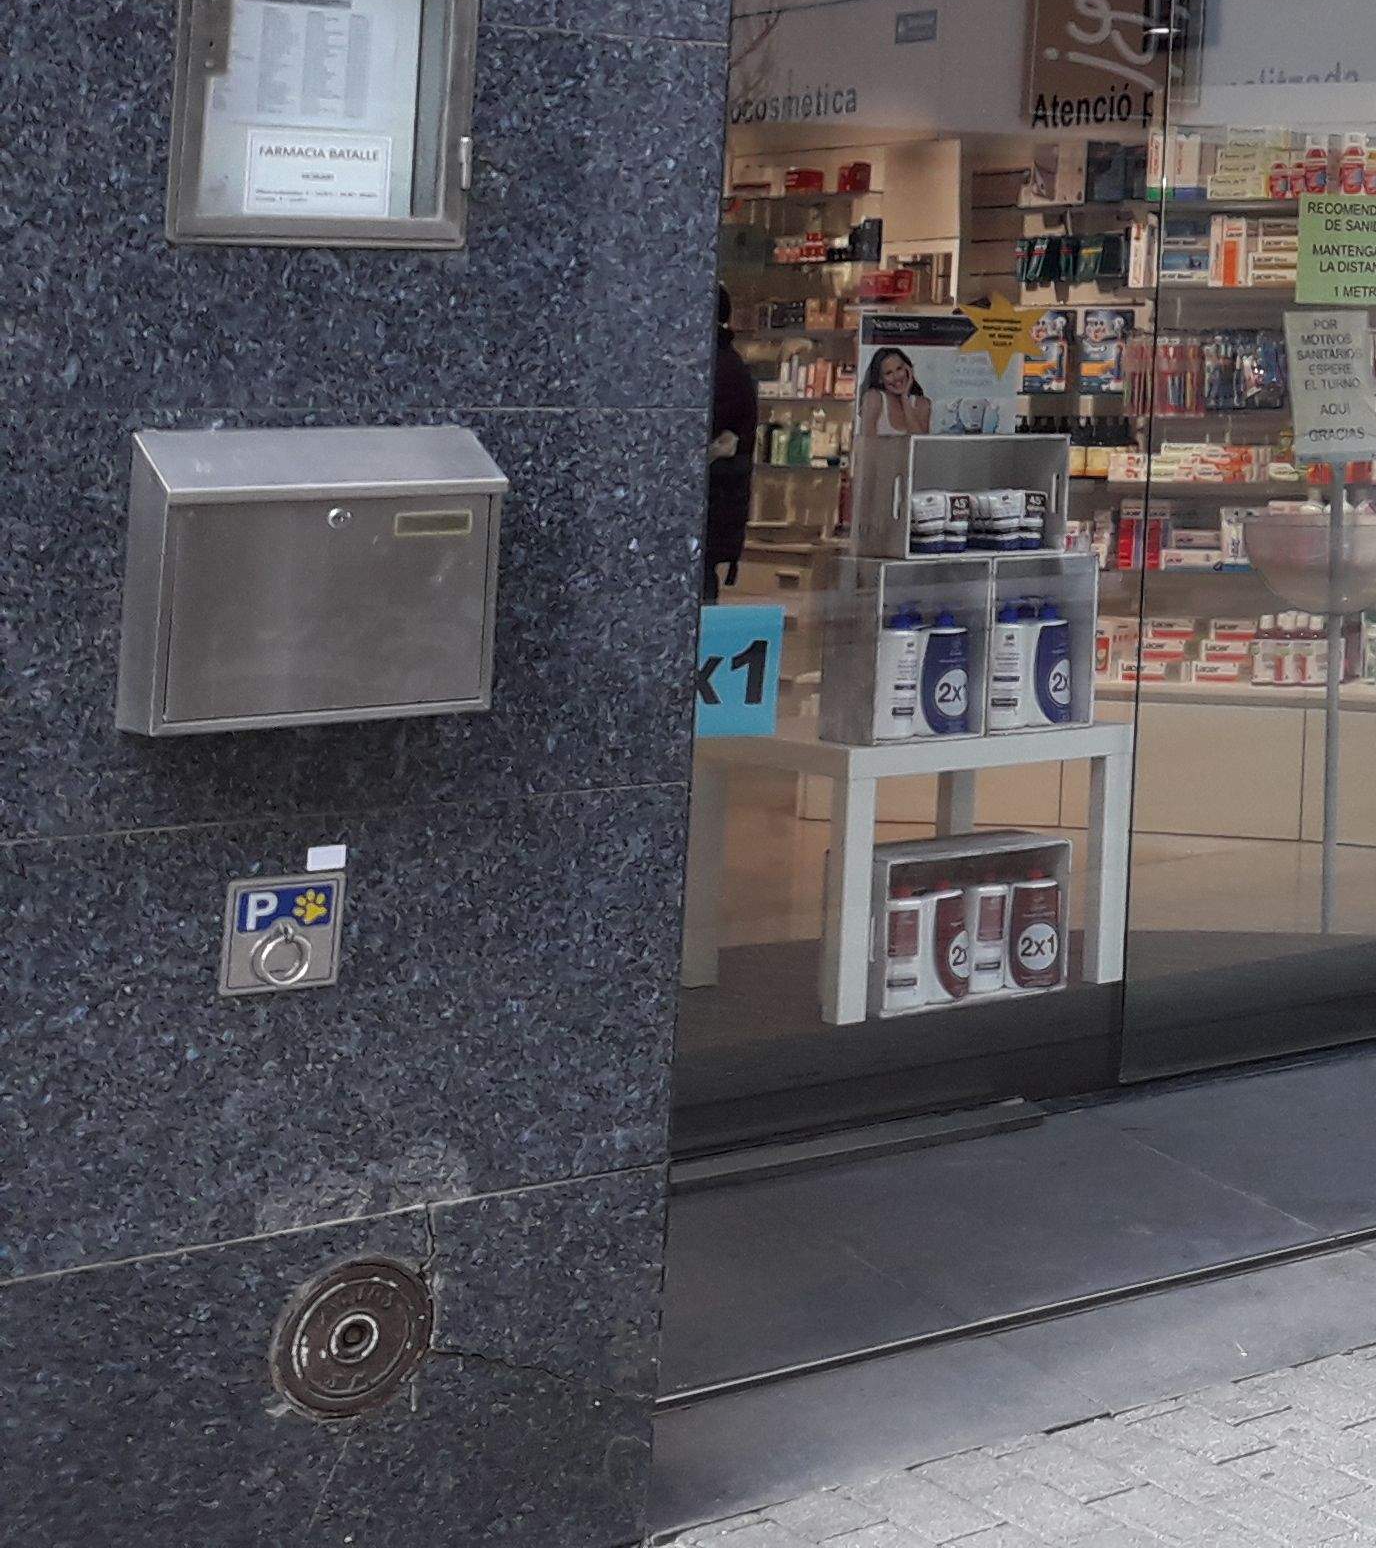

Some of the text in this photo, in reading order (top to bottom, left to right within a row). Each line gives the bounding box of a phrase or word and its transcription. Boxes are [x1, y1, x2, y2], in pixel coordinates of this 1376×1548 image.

[1031, 83, 1132, 129] Atenció
[1324, 218, 1342, 232] DE
[1319, 261, 1335, 273] LA
[1334, 286, 1339, 297] 1
[1313, 318, 1338, 330] POR
[1308, 362, 1354, 375] ESPERE
[1304, 378, 1361, 391] EL TURNO
[1308, 426, 1366, 442] GRACIAS
[937, 681, 968, 704] 2x
[245, 890, 279, 931] P
[1020, 934, 1055, 957] 2x1
